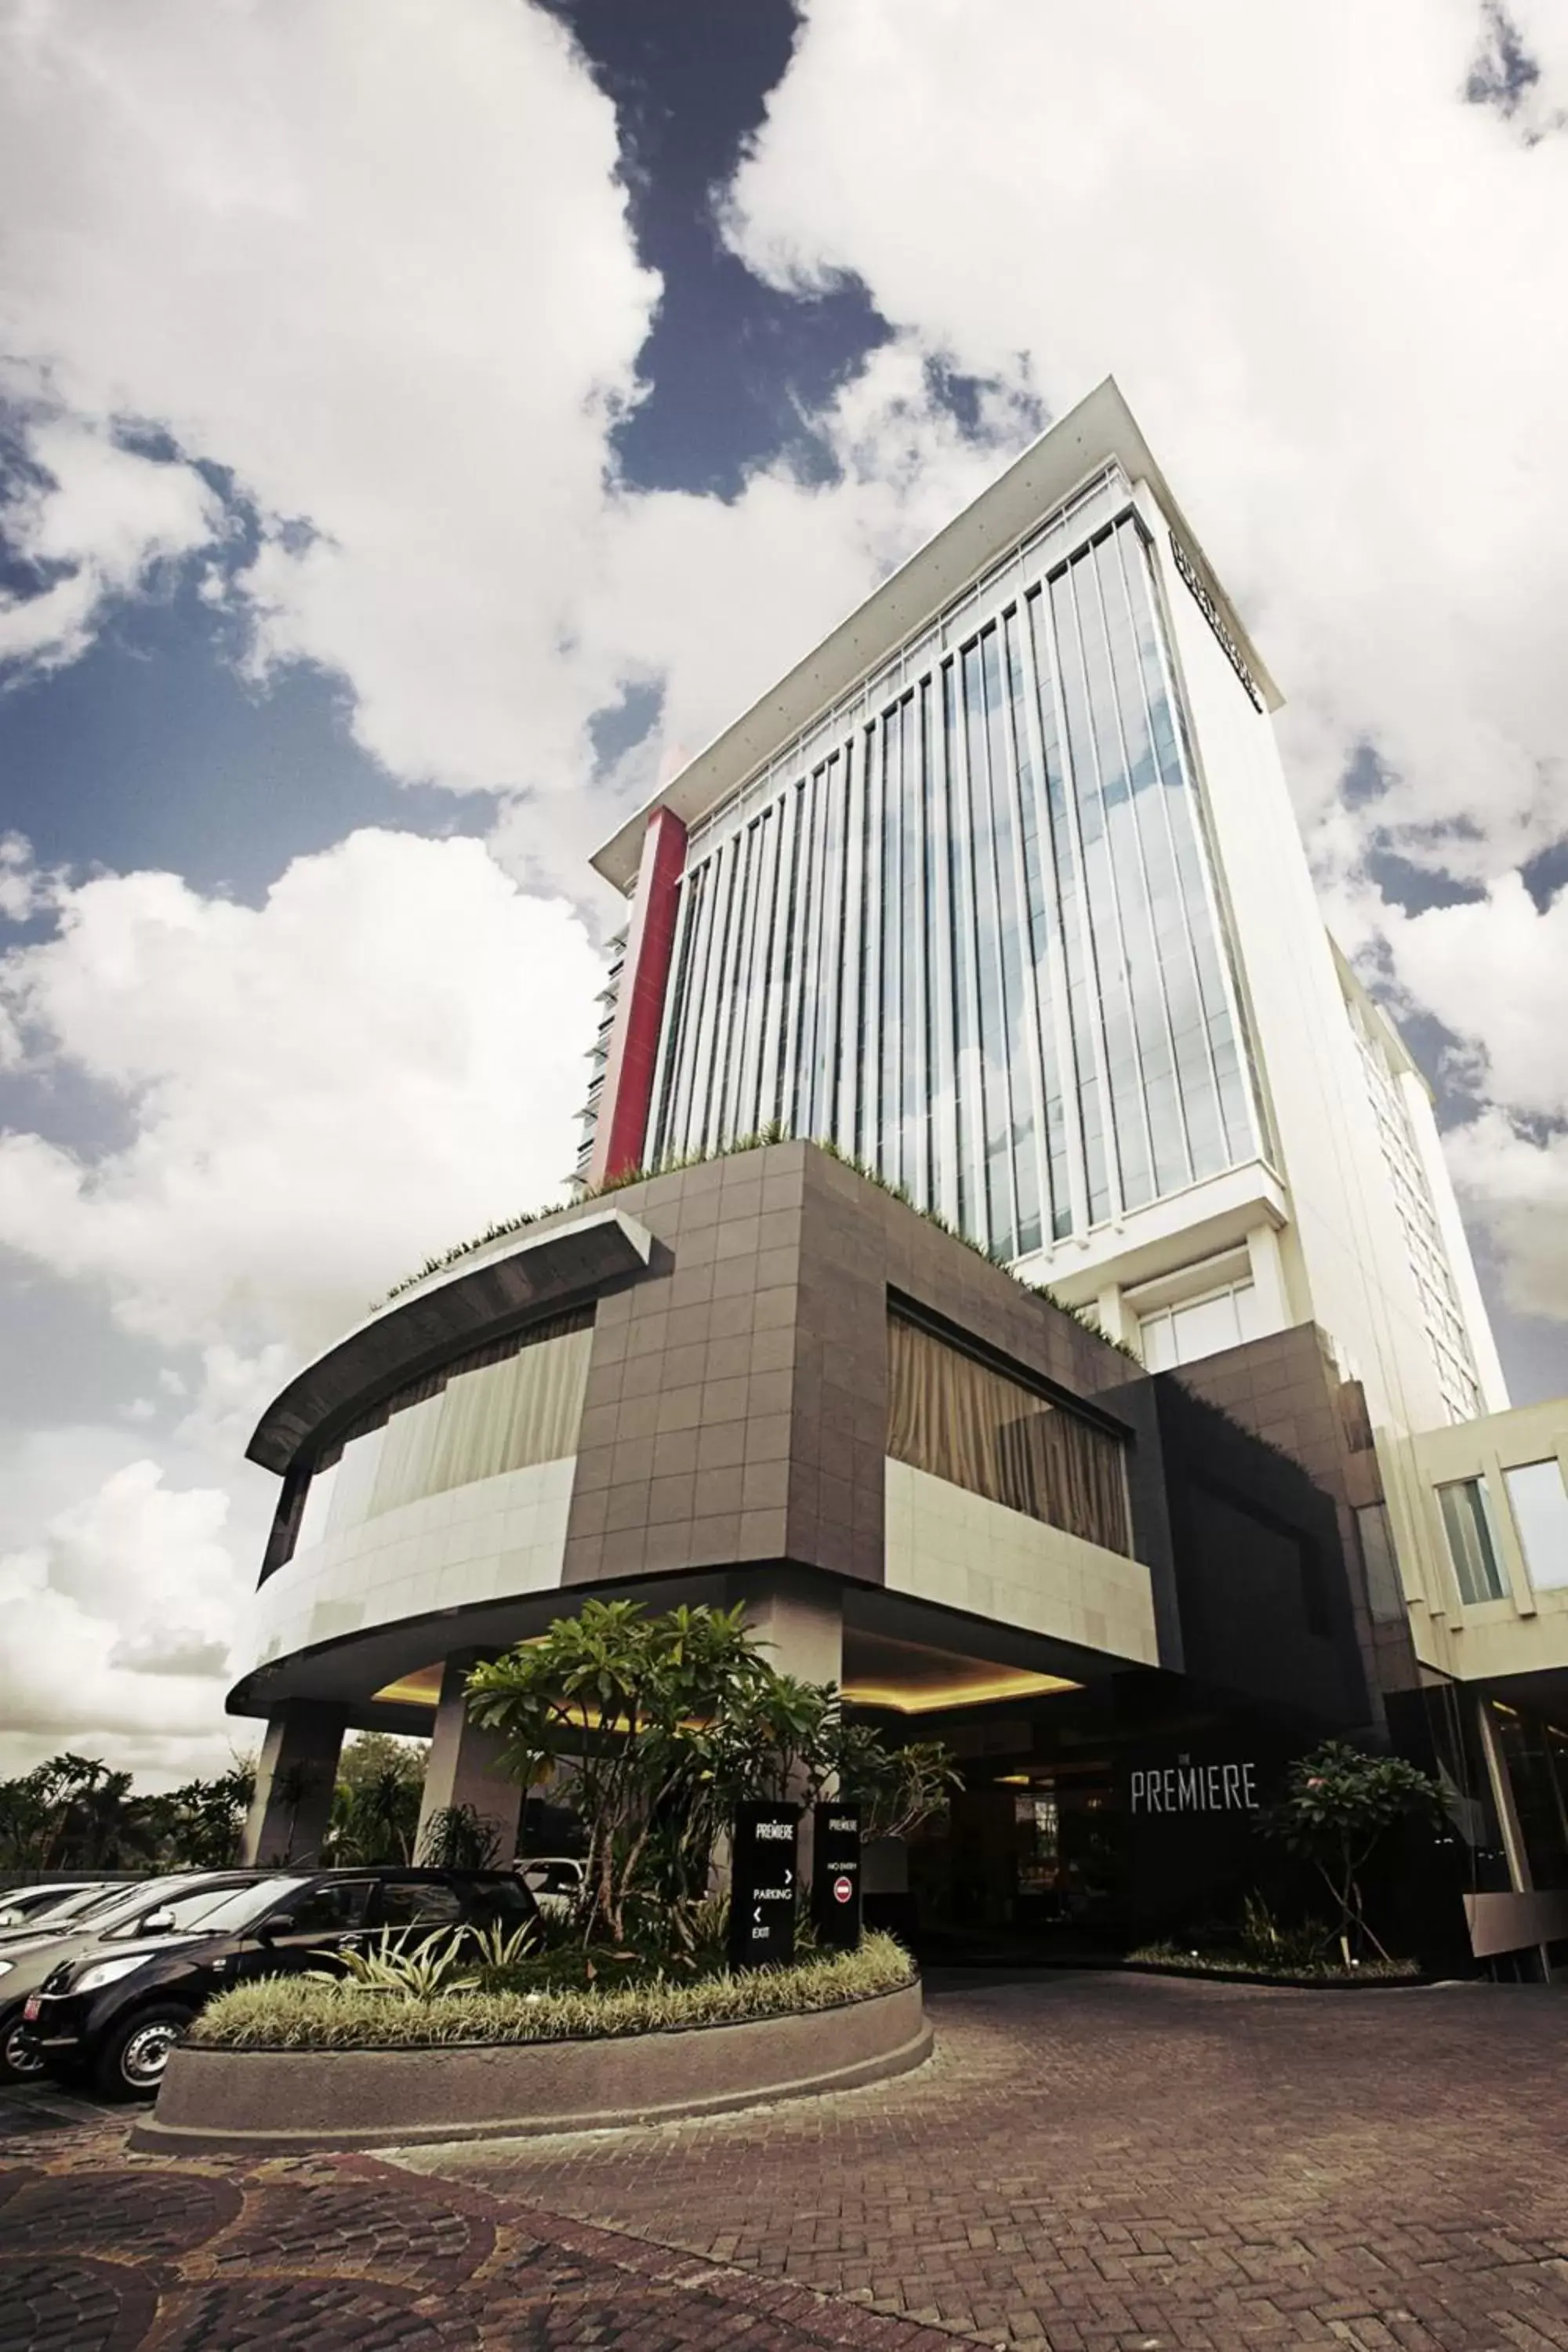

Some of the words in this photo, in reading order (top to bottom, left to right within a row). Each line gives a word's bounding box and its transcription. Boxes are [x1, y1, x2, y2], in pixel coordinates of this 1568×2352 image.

[1131, 1762, 1259, 1814] PREMIERE
[756, 1823, 793, 1841] PREMIERE
[753, 1889, 793, 1900] PARKING
[753, 1926, 770, 1938] EXIT
